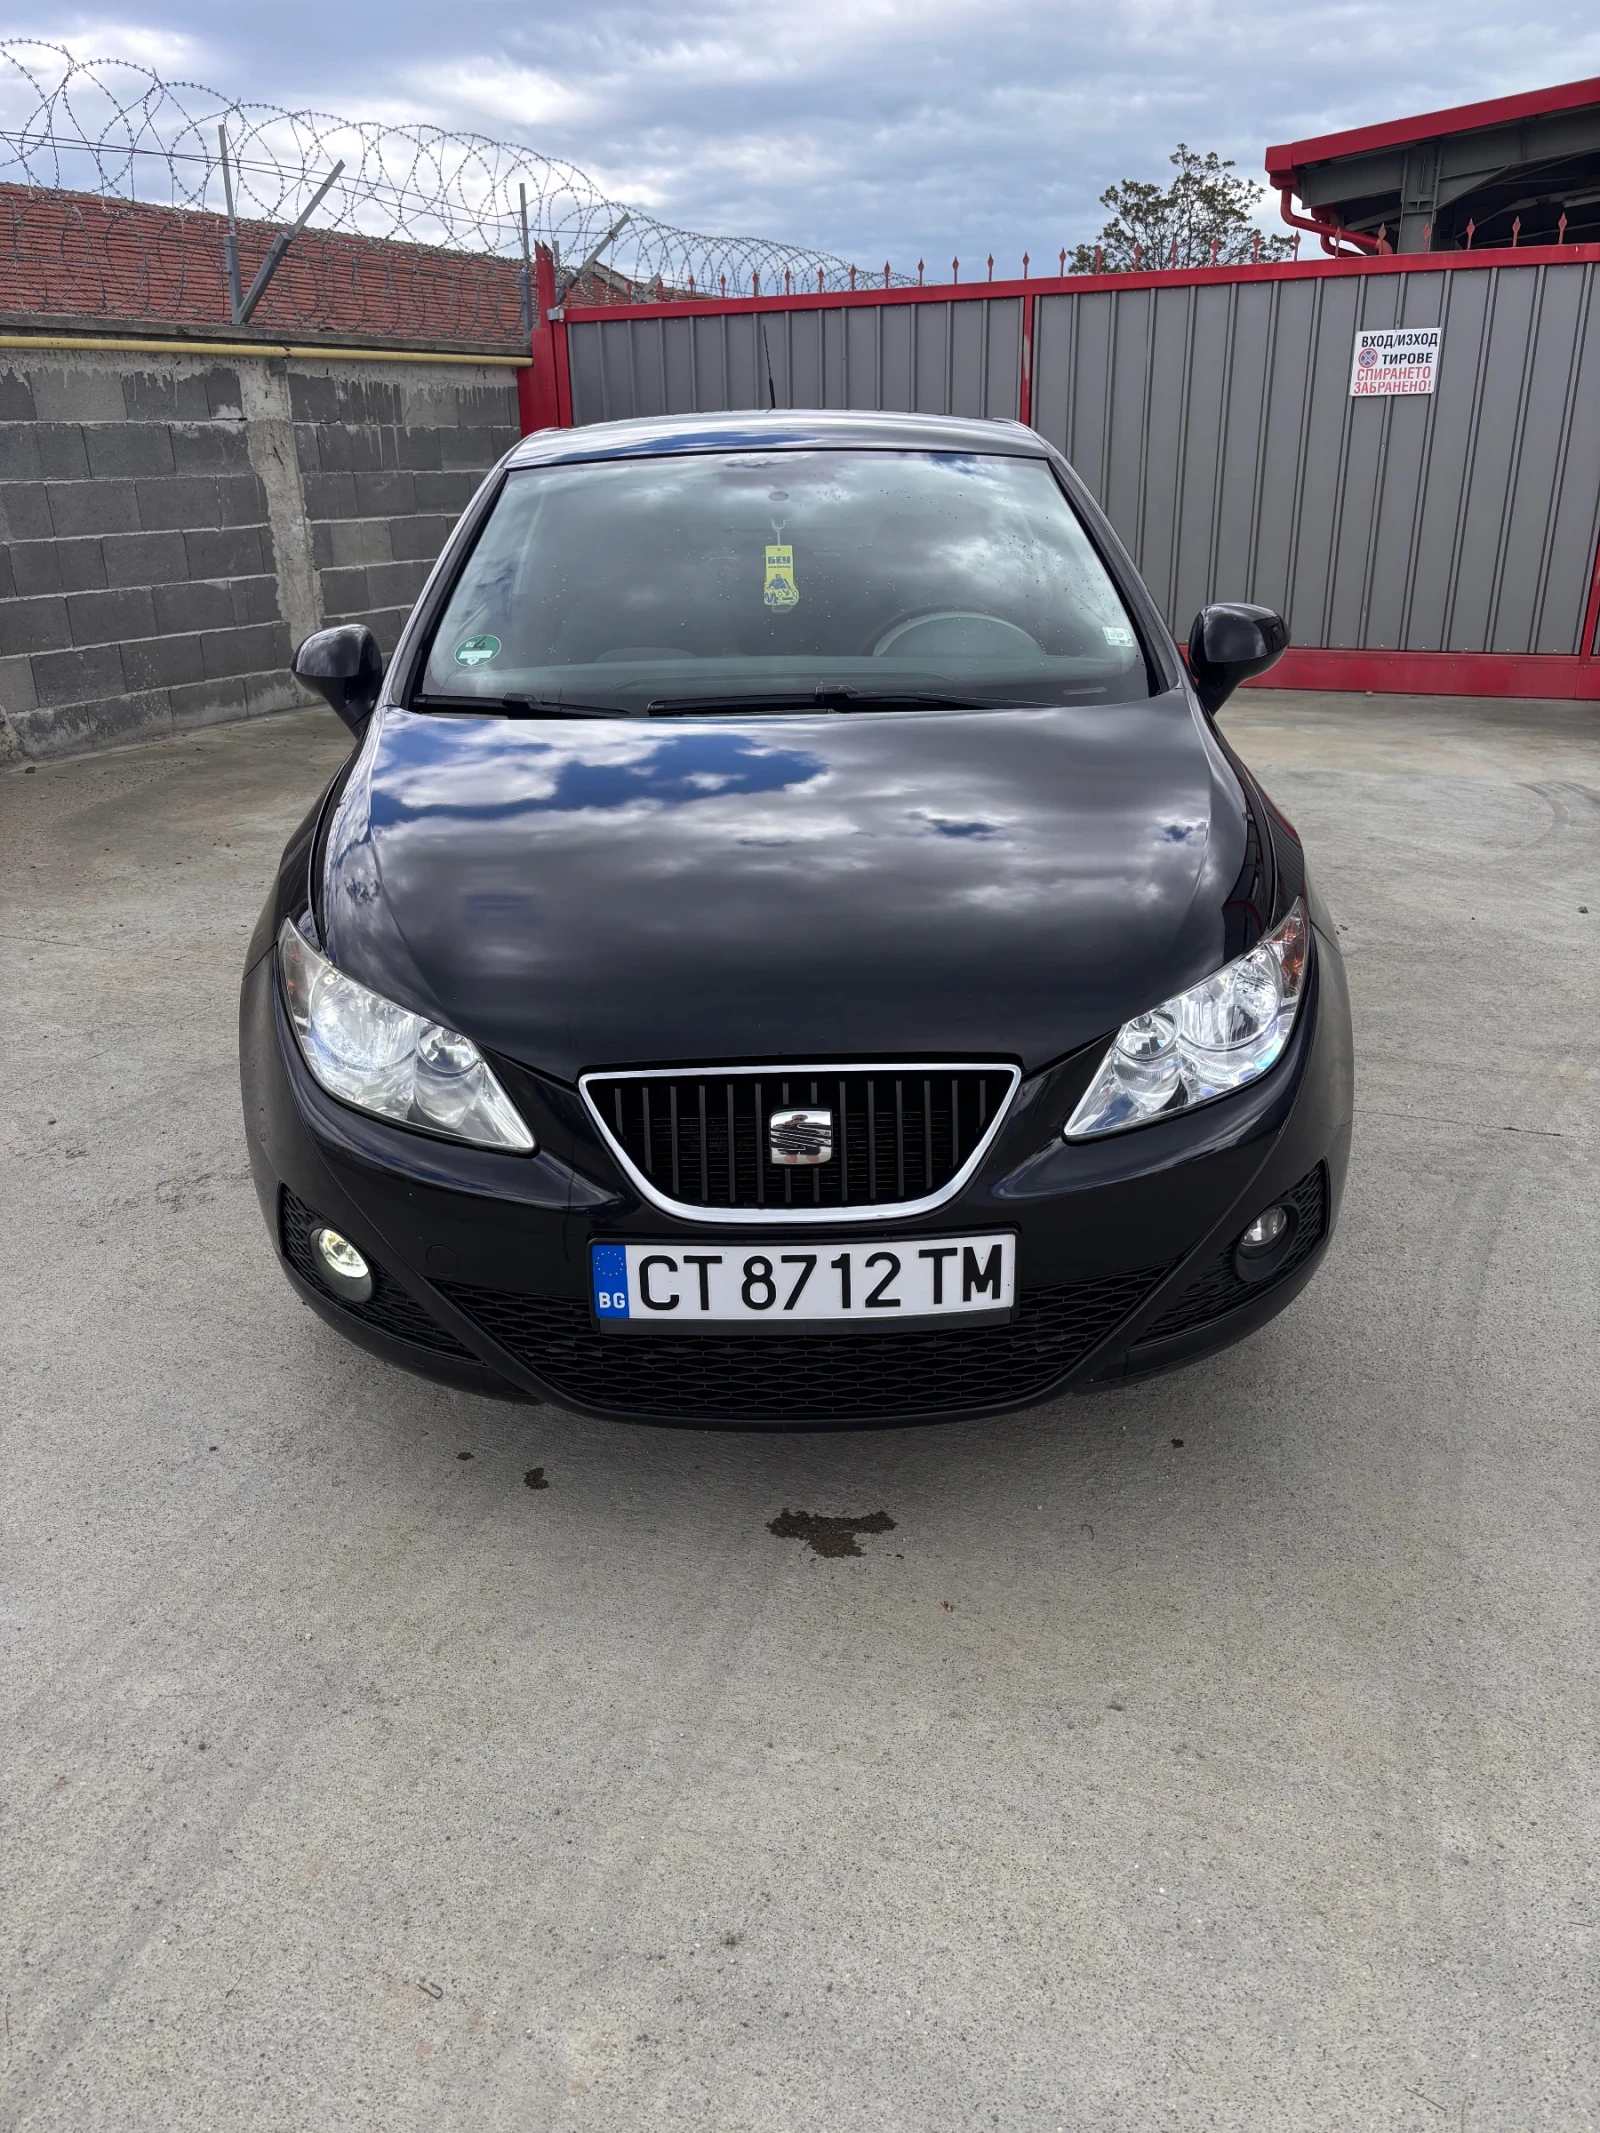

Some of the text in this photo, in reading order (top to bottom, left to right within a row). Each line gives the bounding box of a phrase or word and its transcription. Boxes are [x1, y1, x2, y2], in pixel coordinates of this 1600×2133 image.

[1361, 332, 1438, 349] ВХОД/ИЗХОД
[1381, 352, 1433, 365] ТИРОВЕ
[1357, 366, 1431, 381] СПИРАНЕТО
[1353, 380, 1431, 394] ЗАБРАНЕНО!
[638, 1244, 1003, 1311] CT 8712 TM
[598, 1292, 626, 1309] BG
